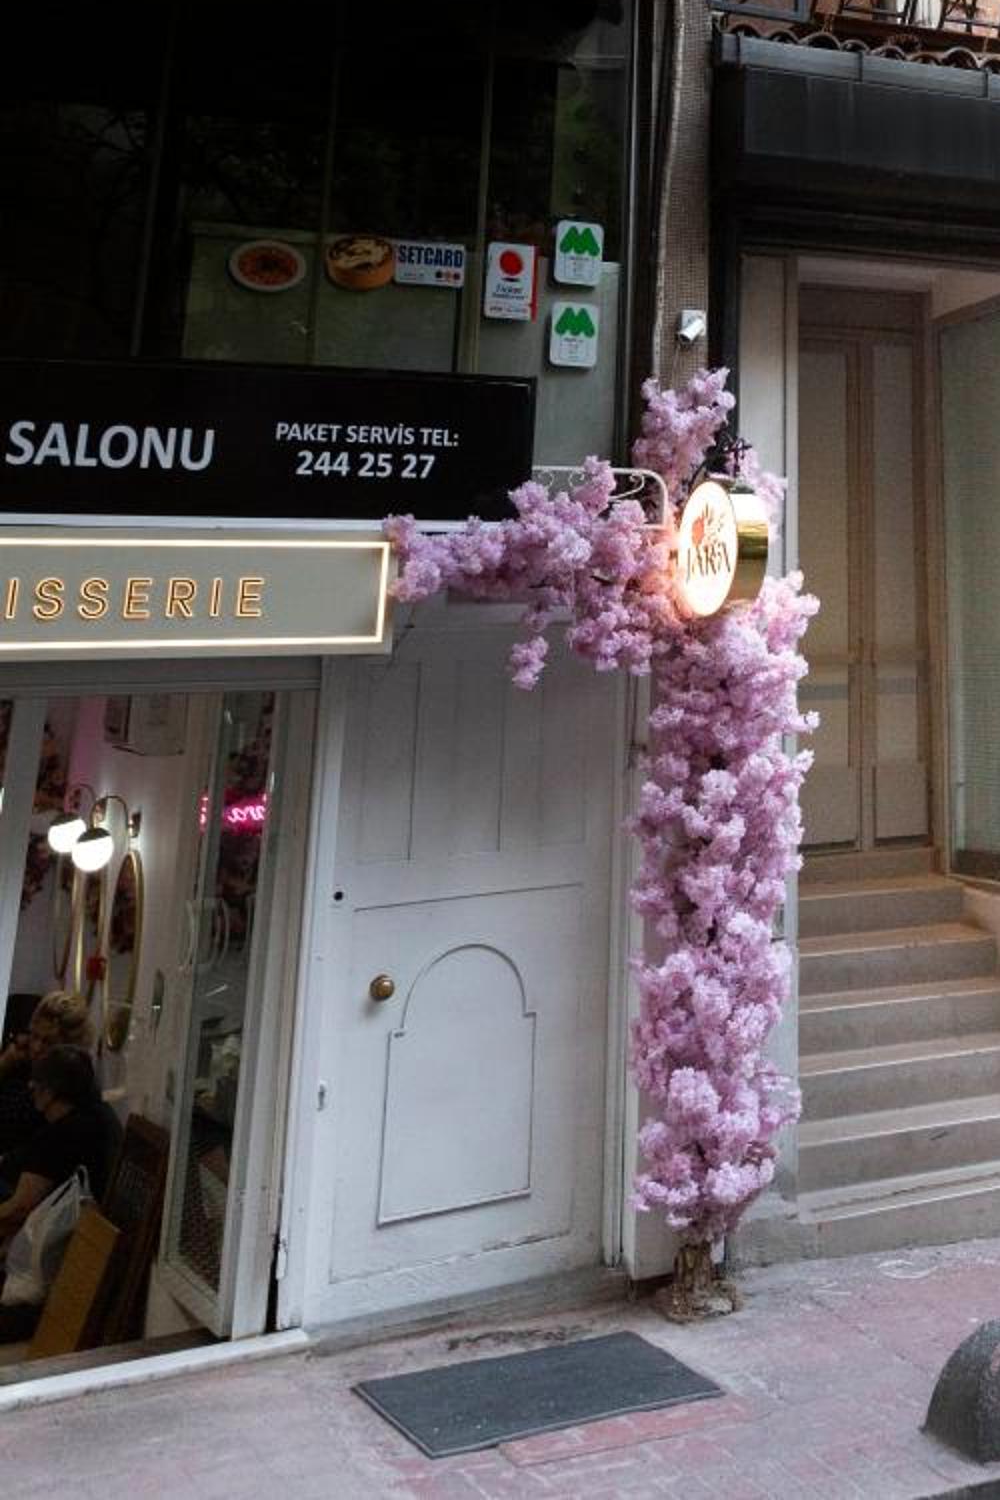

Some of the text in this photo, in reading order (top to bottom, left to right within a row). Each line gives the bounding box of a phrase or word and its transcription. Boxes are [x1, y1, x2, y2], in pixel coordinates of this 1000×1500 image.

[398, 244, 464, 268] SETCARD
[5, 420, 215, 471] SALONU
[275, 422, 459, 447] PAKET SERVİS TEL:
[295, 450, 436, 479] 244 25 27
[5, 577, 265, 620] ISSERIE
